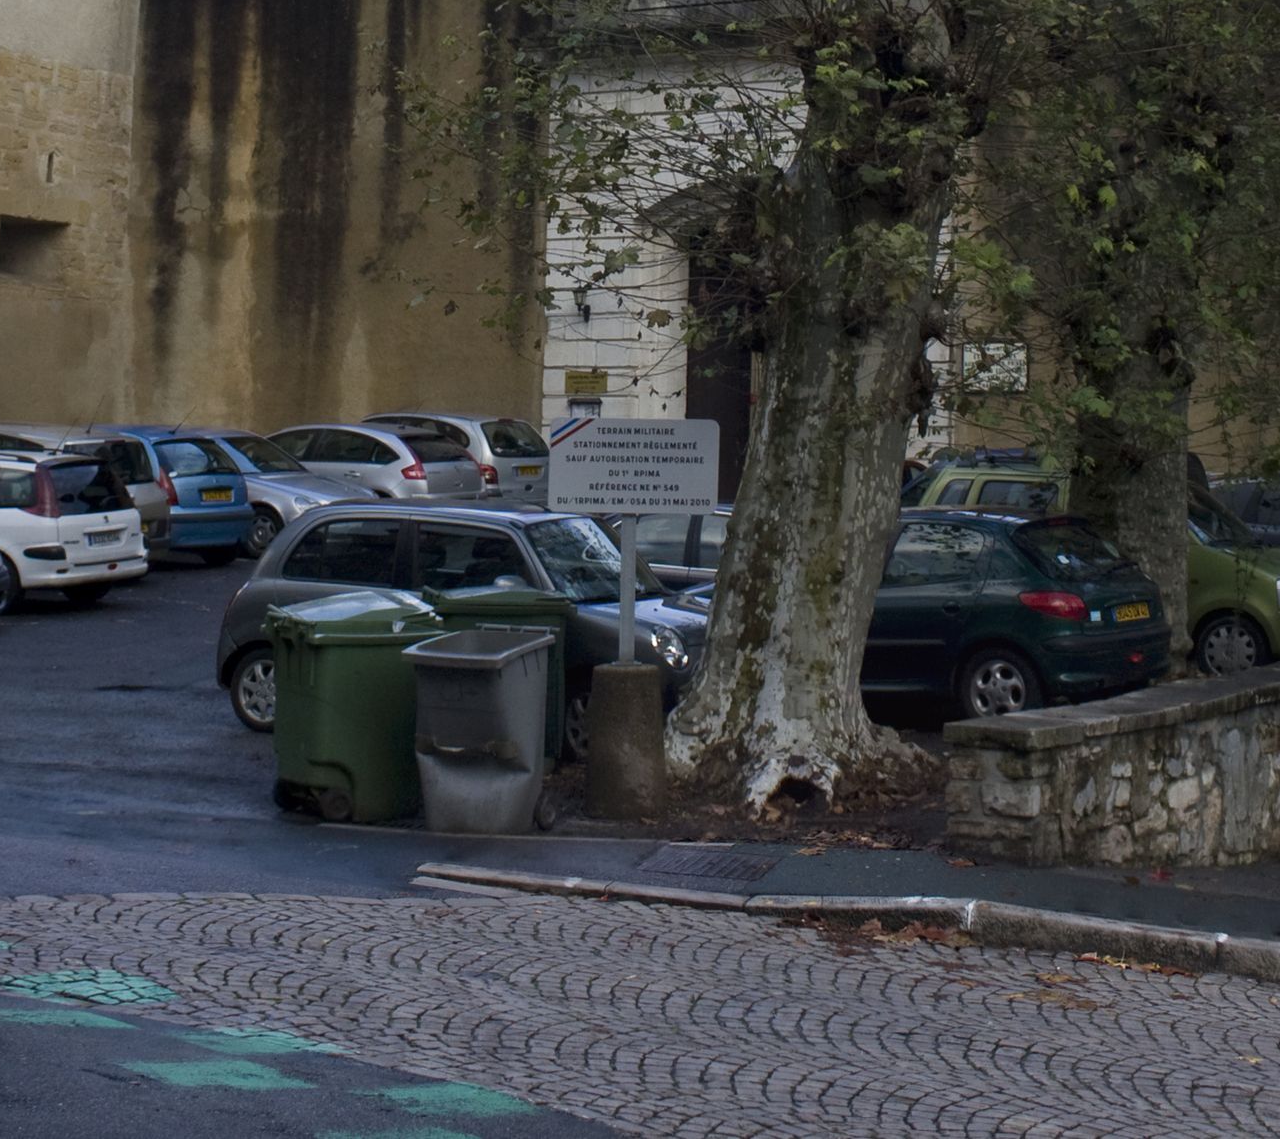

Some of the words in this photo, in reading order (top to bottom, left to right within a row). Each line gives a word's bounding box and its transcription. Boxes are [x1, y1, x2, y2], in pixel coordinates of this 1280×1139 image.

[597, 427, 632, 435] TERRAIN
[634, 428, 675, 436] MILITAIRE
[573, 441, 641, 449] STATIONNEMENT
[566, 455, 587, 463] SAUF
[590, 455, 649, 463] AUTORISATION
[652, 455, 705, 464] TEMPORAIRE
[608, 469, 620, 477] DU
[634, 470, 661, 478] RPIMA
[589, 482, 637, 492] RÉFÉRENCE
[664, 484, 680, 492] 549
[649, 497, 661, 506] DU
[662, 498, 672, 506] 31
[673, 498, 688, 506] MAI
[690, 498, 711, 507] 2010
